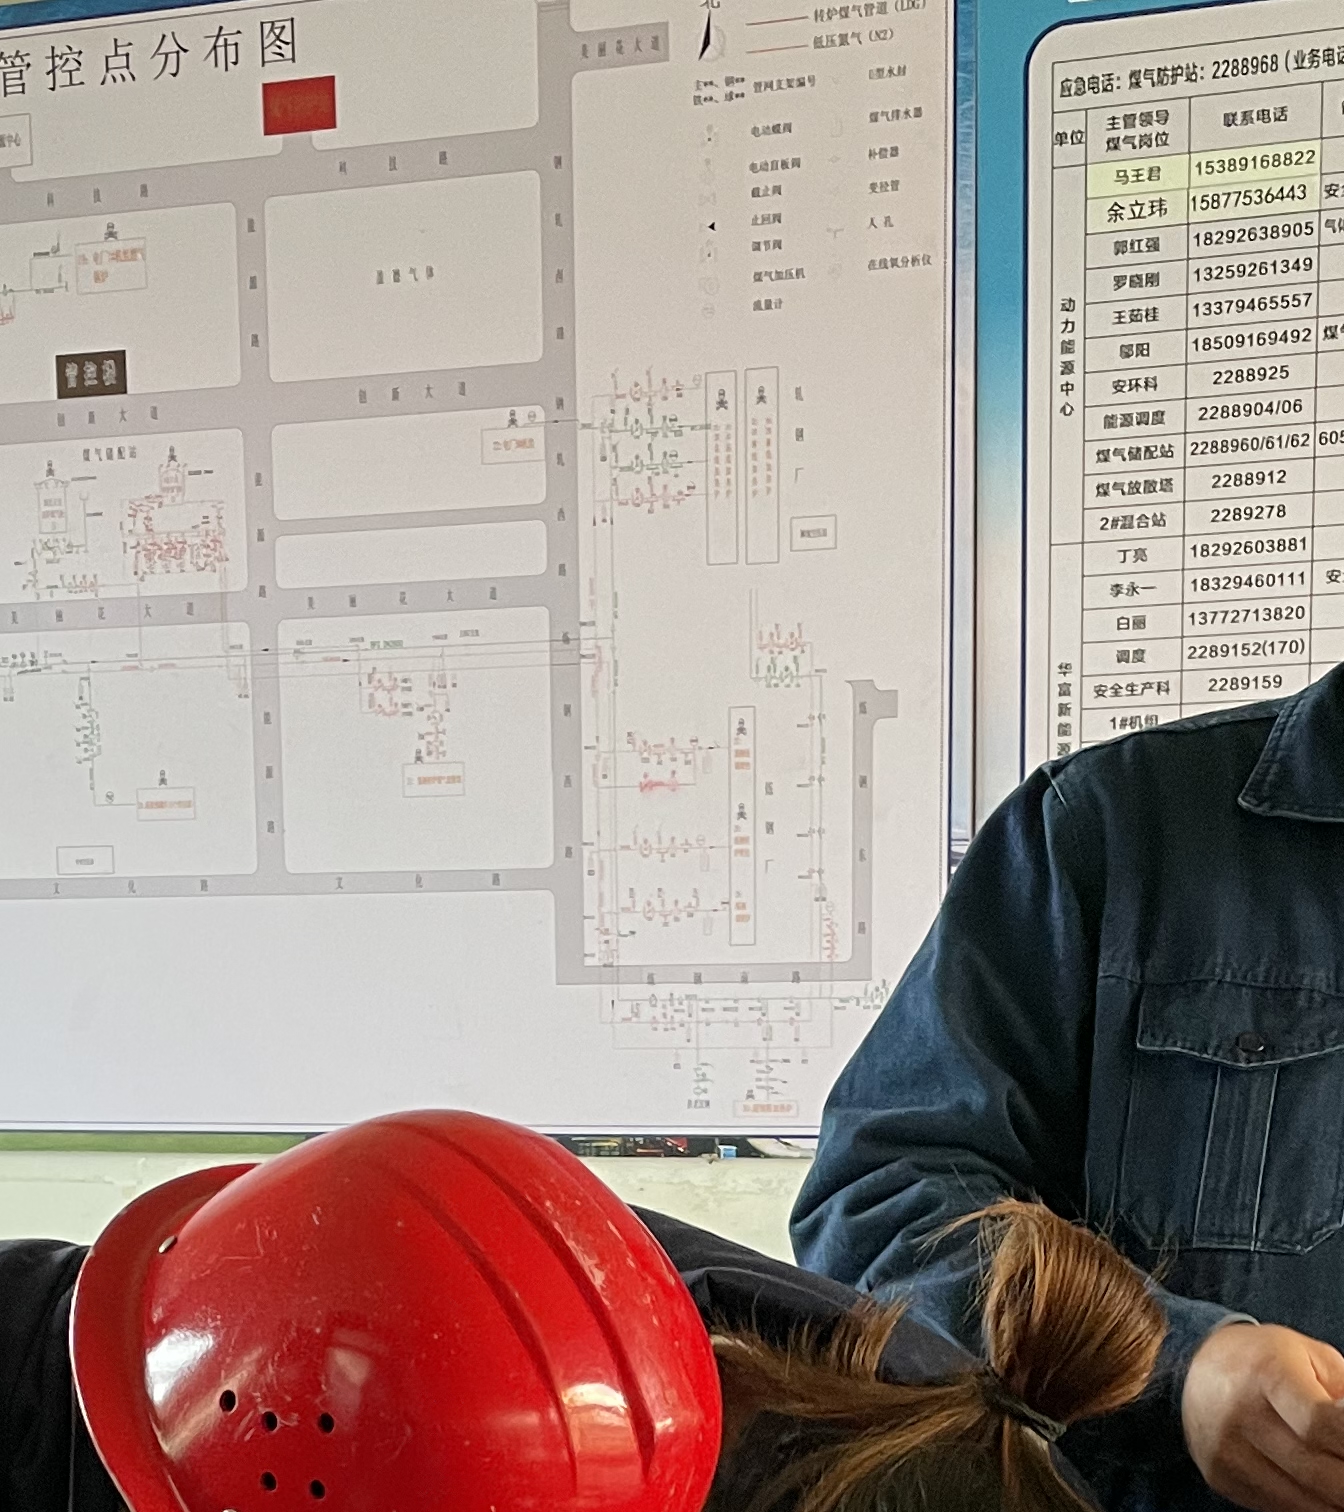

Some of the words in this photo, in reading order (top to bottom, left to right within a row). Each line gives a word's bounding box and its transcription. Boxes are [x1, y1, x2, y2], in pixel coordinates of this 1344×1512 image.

[1106, 109, 1169, 131] 主管领导
[1224, 106, 1288, 127] 联系电话
[1055, 129, 1085, 147] 单位
[1106, 131, 1169, 152] 煤气岗位
[1195, 150, 1315, 178] 15389168822
[1114, 166, 1161, 185] 马王君
[1192, 184, 1306, 211] 15877536443
[1193, 221, 1313, 247] 18292638905
[1194, 257, 1312, 282] 13259261349
[1193, 293, 1312, 317] 13379465557
[1192, 328, 1311, 351] 18509169492
[1112, 376, 1157, 394] 安环科
[1213, 365, 1289, 385] 2288925
[1199, 399, 1302, 421] 2288904/06
[1191, 433, 1309, 455] 2288960/61/62
[1212, 470, 1286, 488] 2288912
[1211, 504, 1286, 522] 2289278
[1117, 548, 1147, 563] 丁亮
[1190, 537, 1306, 557] 18292603881
[1191, 571, 1304, 592] 18329460111
[1189, 606, 1305, 625] 13772713820
[1116, 649, 1146, 663] 调度
[1188, 638, 1304, 659] 2289152(170)
[1094, 680, 1170, 698] 安全生产科
[1208, 675, 1282, 691] 2289159
